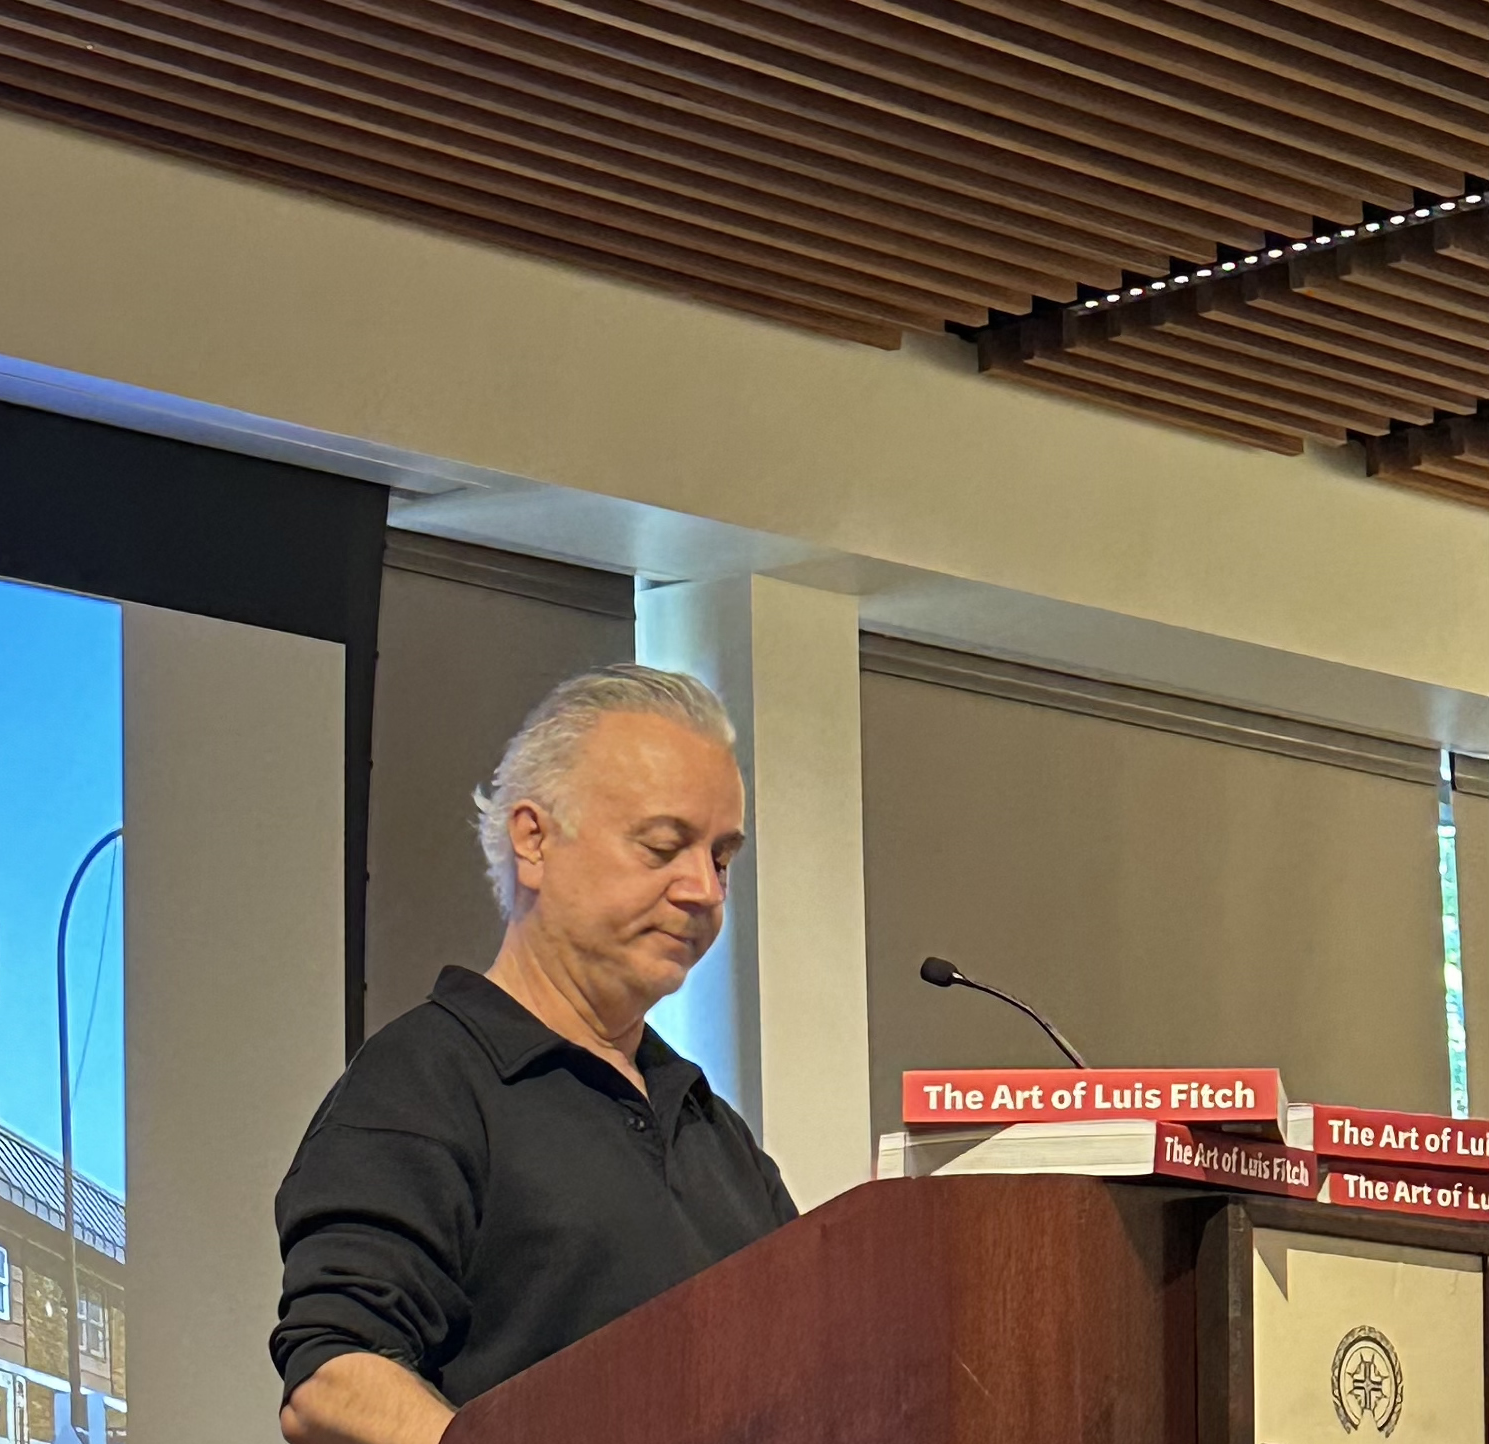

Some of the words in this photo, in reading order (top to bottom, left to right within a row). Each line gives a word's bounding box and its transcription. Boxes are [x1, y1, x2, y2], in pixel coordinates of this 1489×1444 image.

[923, 1082, 984, 1110] The
[990, 1083, 1045, 1110] Art
[1050, 1081, 1088, 1110] of
[1094, 1082, 1163, 1110] Luis
[1170, 1080, 1256, 1110] Fitch
[1328, 1119, 1375, 1147] The
[1379, 1125, 1420, 1152] Art
[1424, 1127, 1452, 1153] of
[1164, 1137, 1193, 1166] The
[1193, 1143, 1220, 1169] Art
[1221, 1147, 1239, 1172] of
[1240, 1151, 1271, 1181] Luis
[1272, 1156, 1310, 1188] Fitch
[1343, 1173, 1390, 1201] The
[1393, 1180, 1433, 1206] Art
[1436, 1182, 1463, 1208] of
